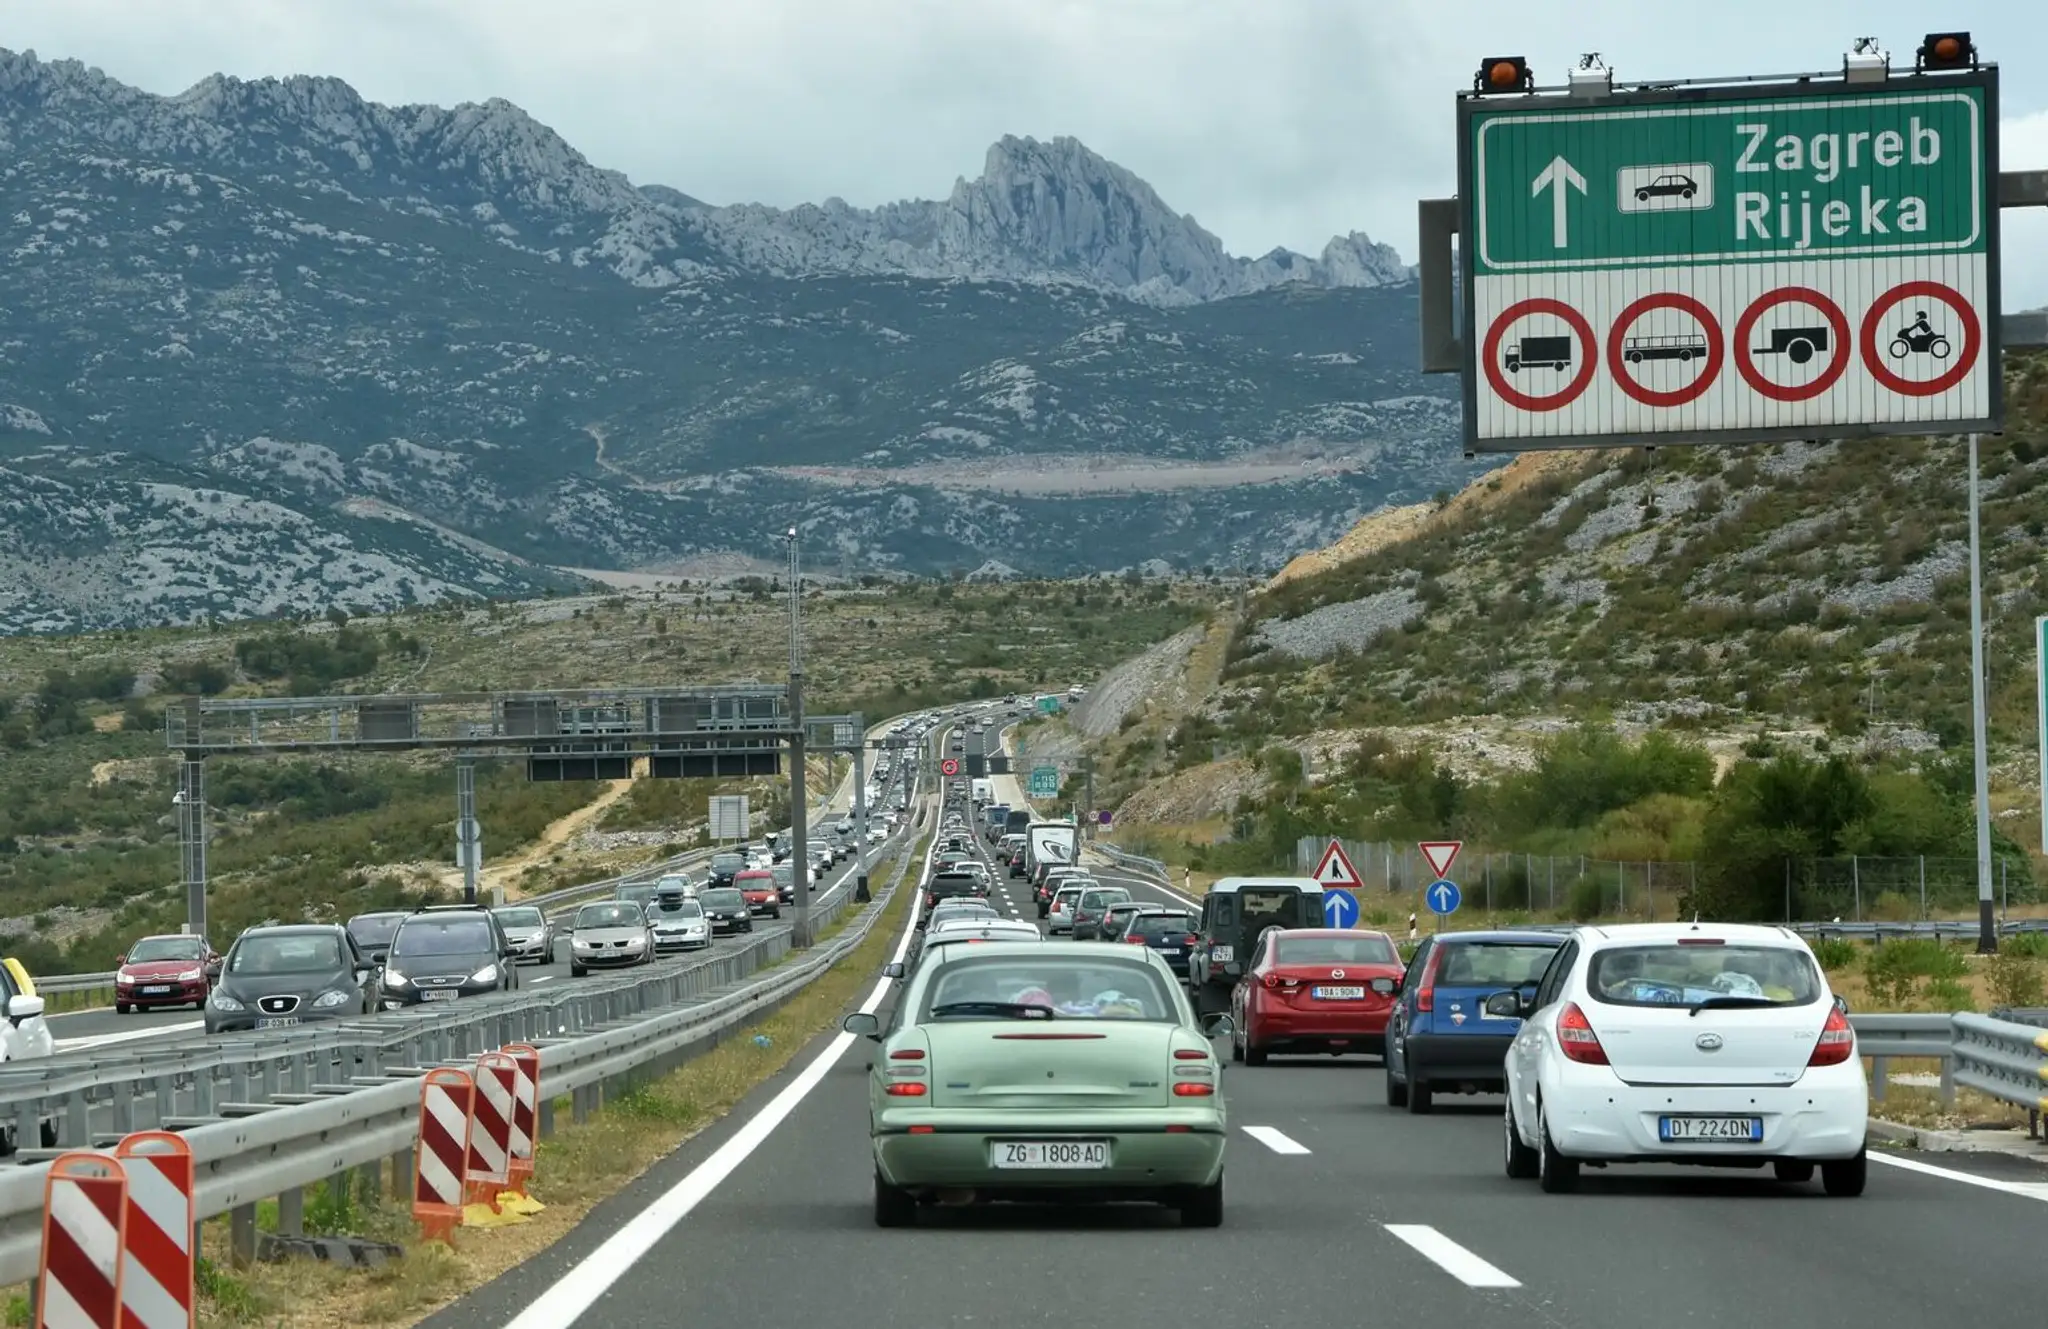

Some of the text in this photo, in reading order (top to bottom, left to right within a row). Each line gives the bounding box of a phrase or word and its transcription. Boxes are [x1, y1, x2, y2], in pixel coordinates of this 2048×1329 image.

[1735, 116, 1940, 183] Zagreb
[1735, 185, 1927, 249] Rijeka
[1671, 1119, 1750, 1136] DY 224DN
[1006, 1143, 1105, 1163] ZG 1808-AD
